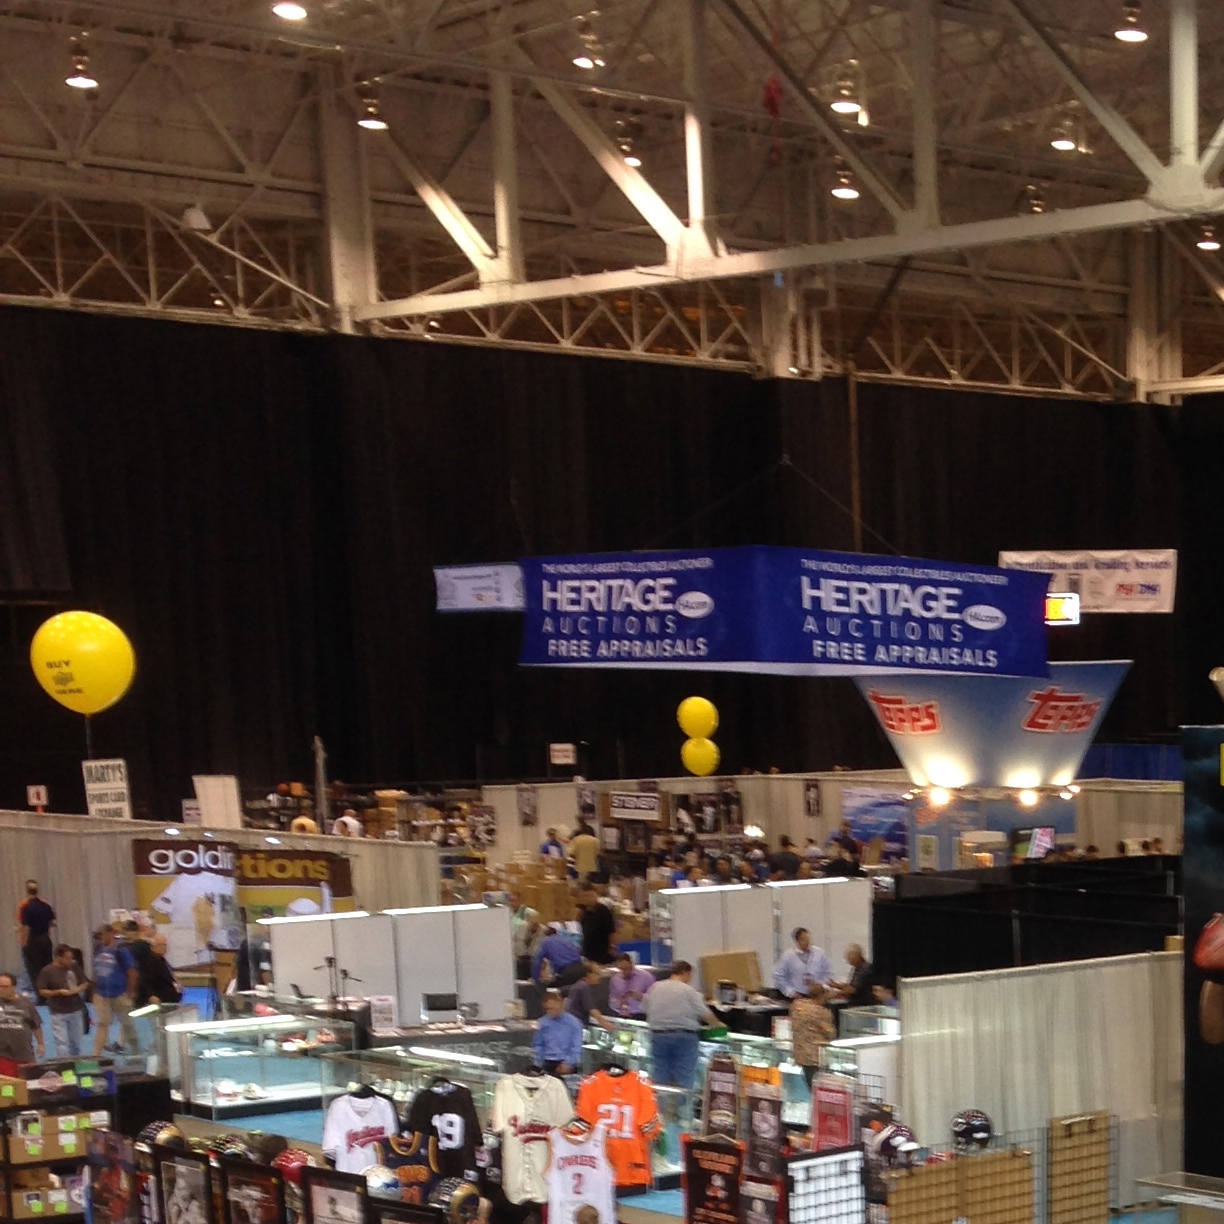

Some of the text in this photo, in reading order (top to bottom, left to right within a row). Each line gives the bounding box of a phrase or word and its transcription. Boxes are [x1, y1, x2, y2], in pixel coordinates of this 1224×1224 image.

[542, 577, 677, 613] HERITAGE
[801, 575, 963, 620] HERITAGE
[542, 614, 677, 636] AUCTIONS
[802, 614, 964, 643] AUCTIONS
[548, 637, 708, 659] FREE APPRAISALS
[812, 639, 999, 668] FREE APPRAISALS
[597, 1103, 634, 1139] 21
[572, 1172, 584, 1195] 2
